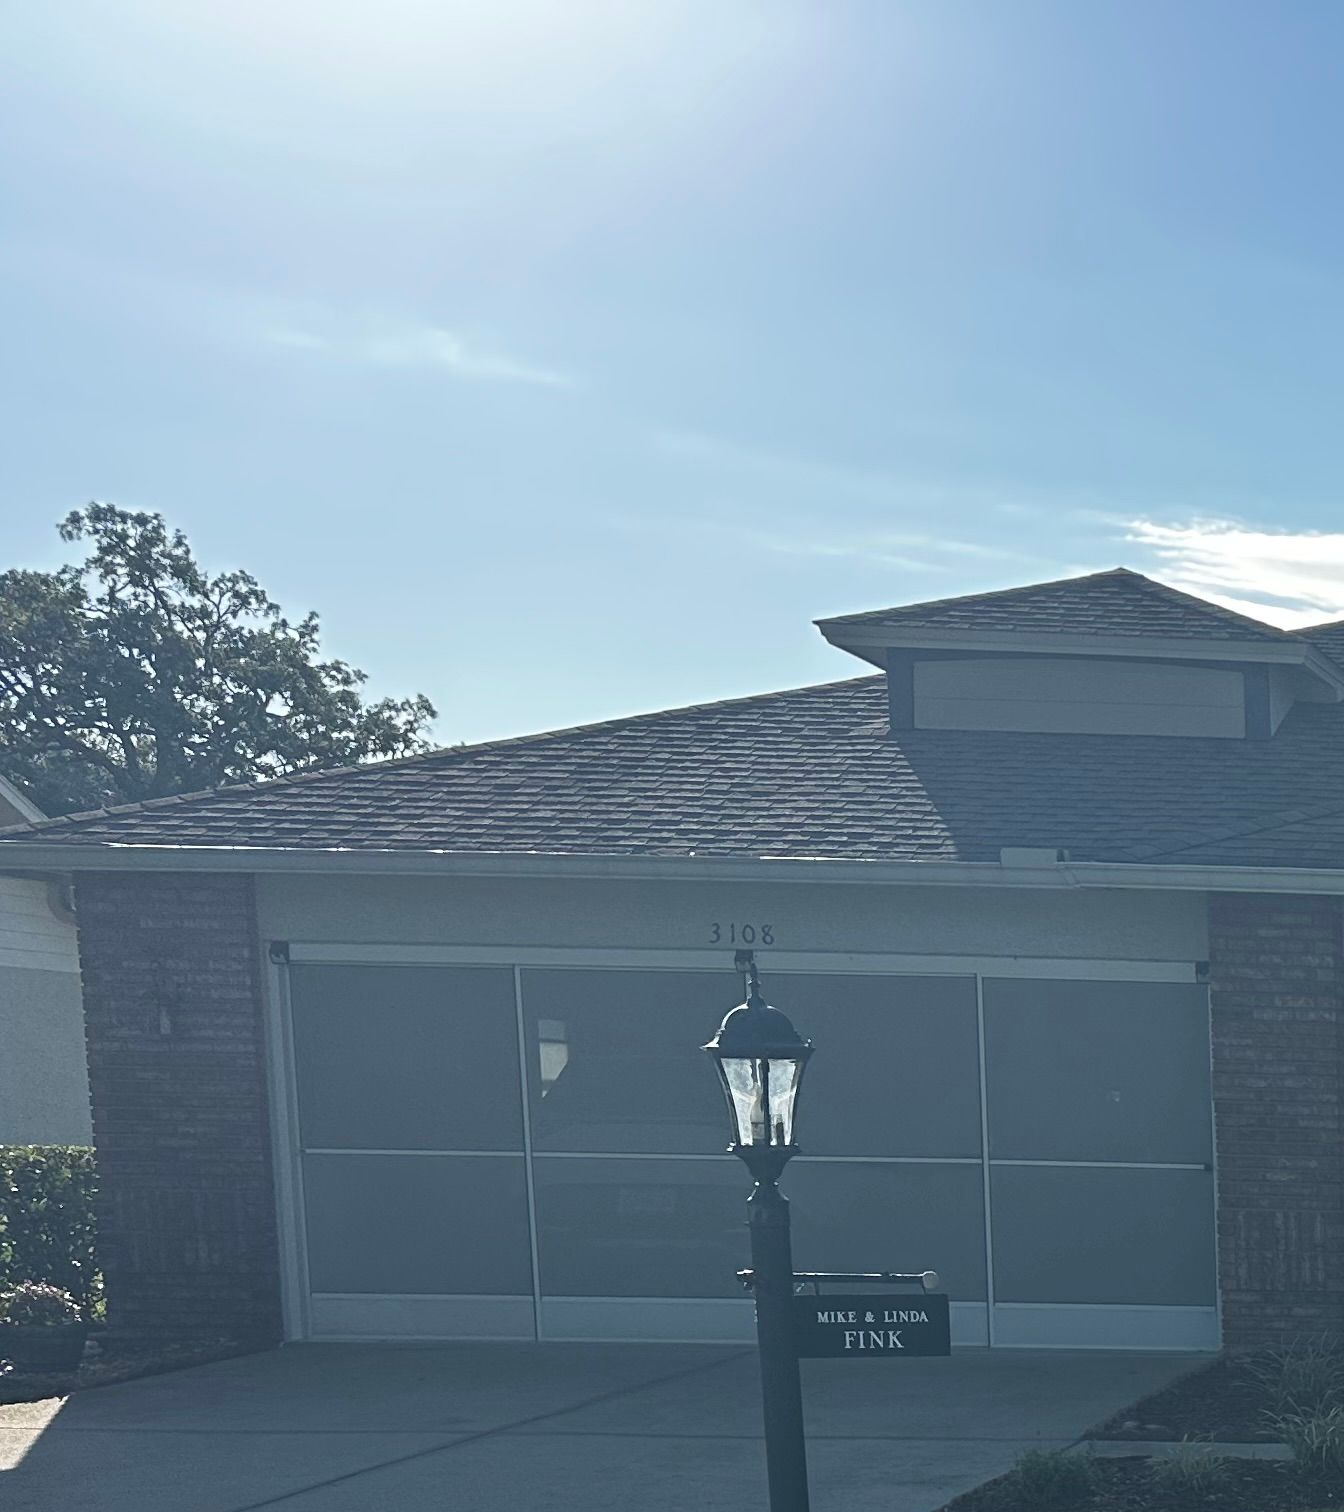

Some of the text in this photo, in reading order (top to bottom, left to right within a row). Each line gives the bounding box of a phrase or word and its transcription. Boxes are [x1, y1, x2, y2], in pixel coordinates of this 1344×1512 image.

[709, 922, 775, 945] 3108
[817, 1310, 929, 1323] MIKE & LINDA
[844, 1330, 905, 1349] FINK
